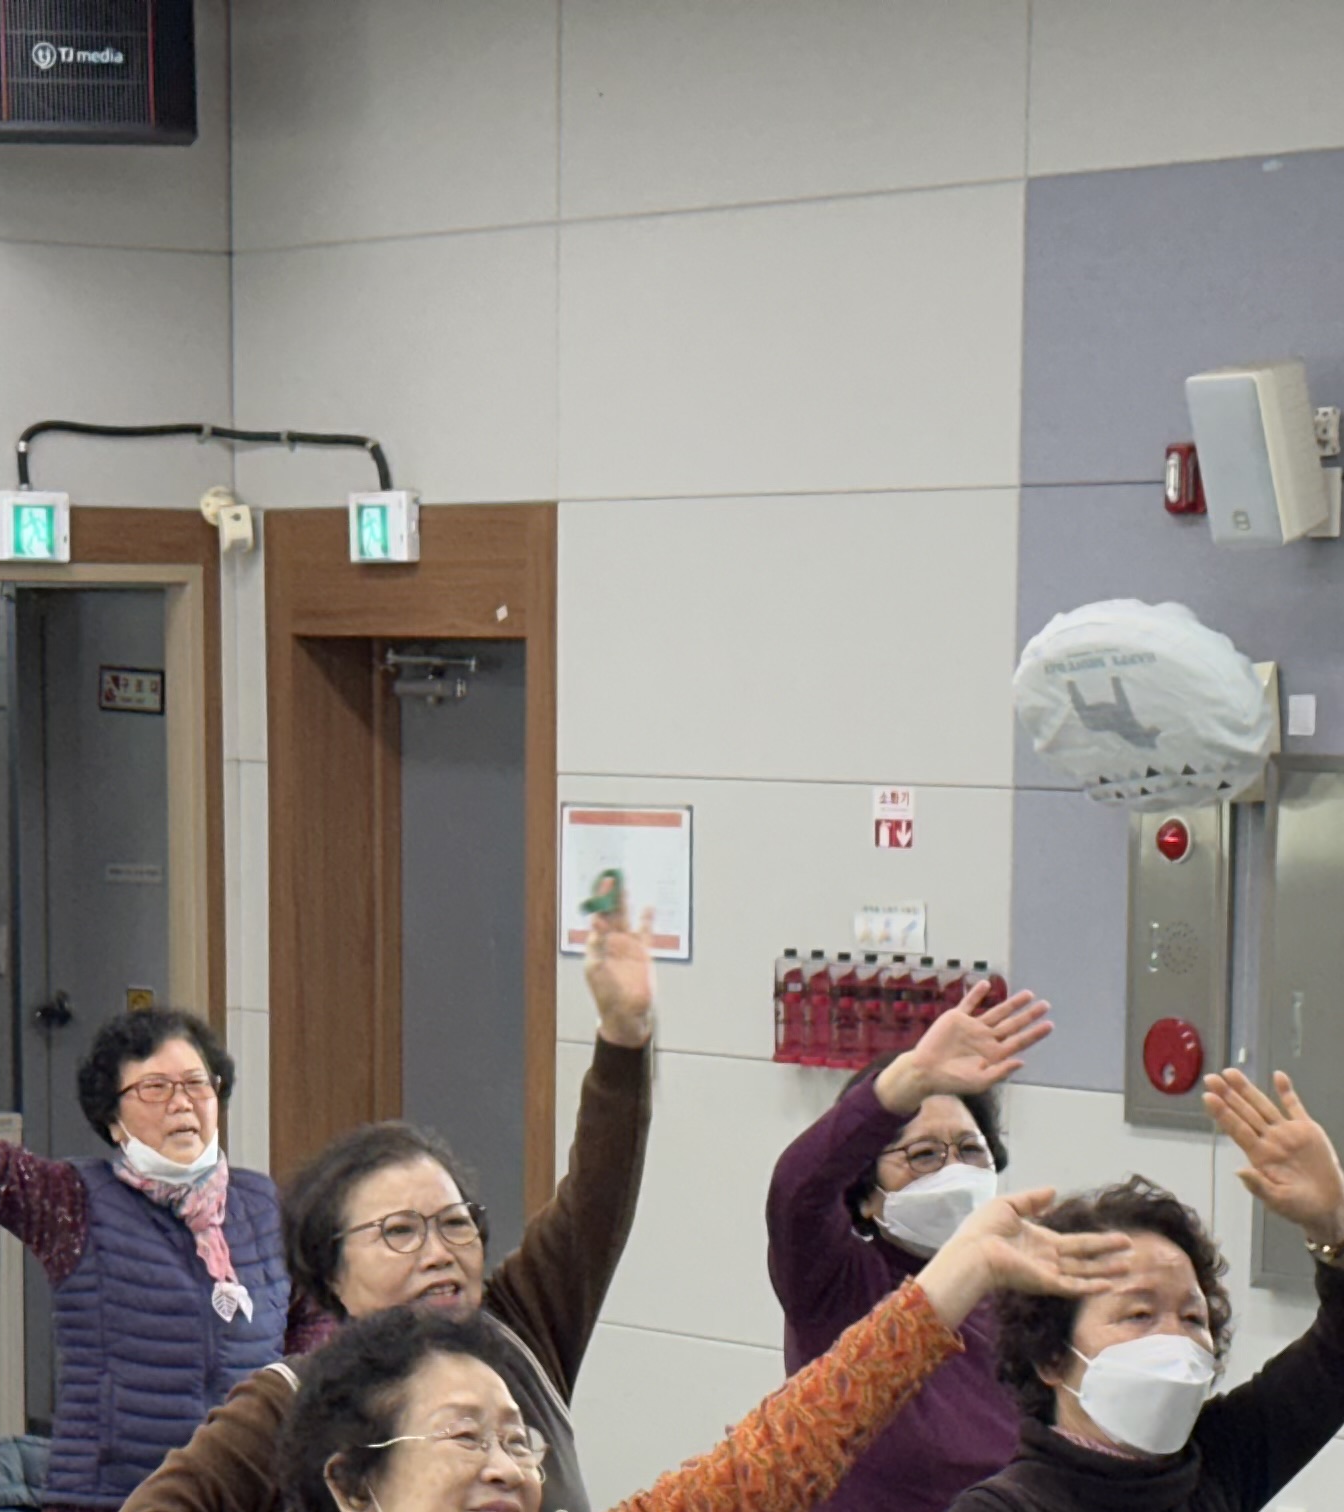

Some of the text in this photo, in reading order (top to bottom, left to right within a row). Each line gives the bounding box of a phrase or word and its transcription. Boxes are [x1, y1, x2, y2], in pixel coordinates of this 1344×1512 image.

[57, 47, 123, 64] TJ media
[879, 790, 910, 807] 소화기
